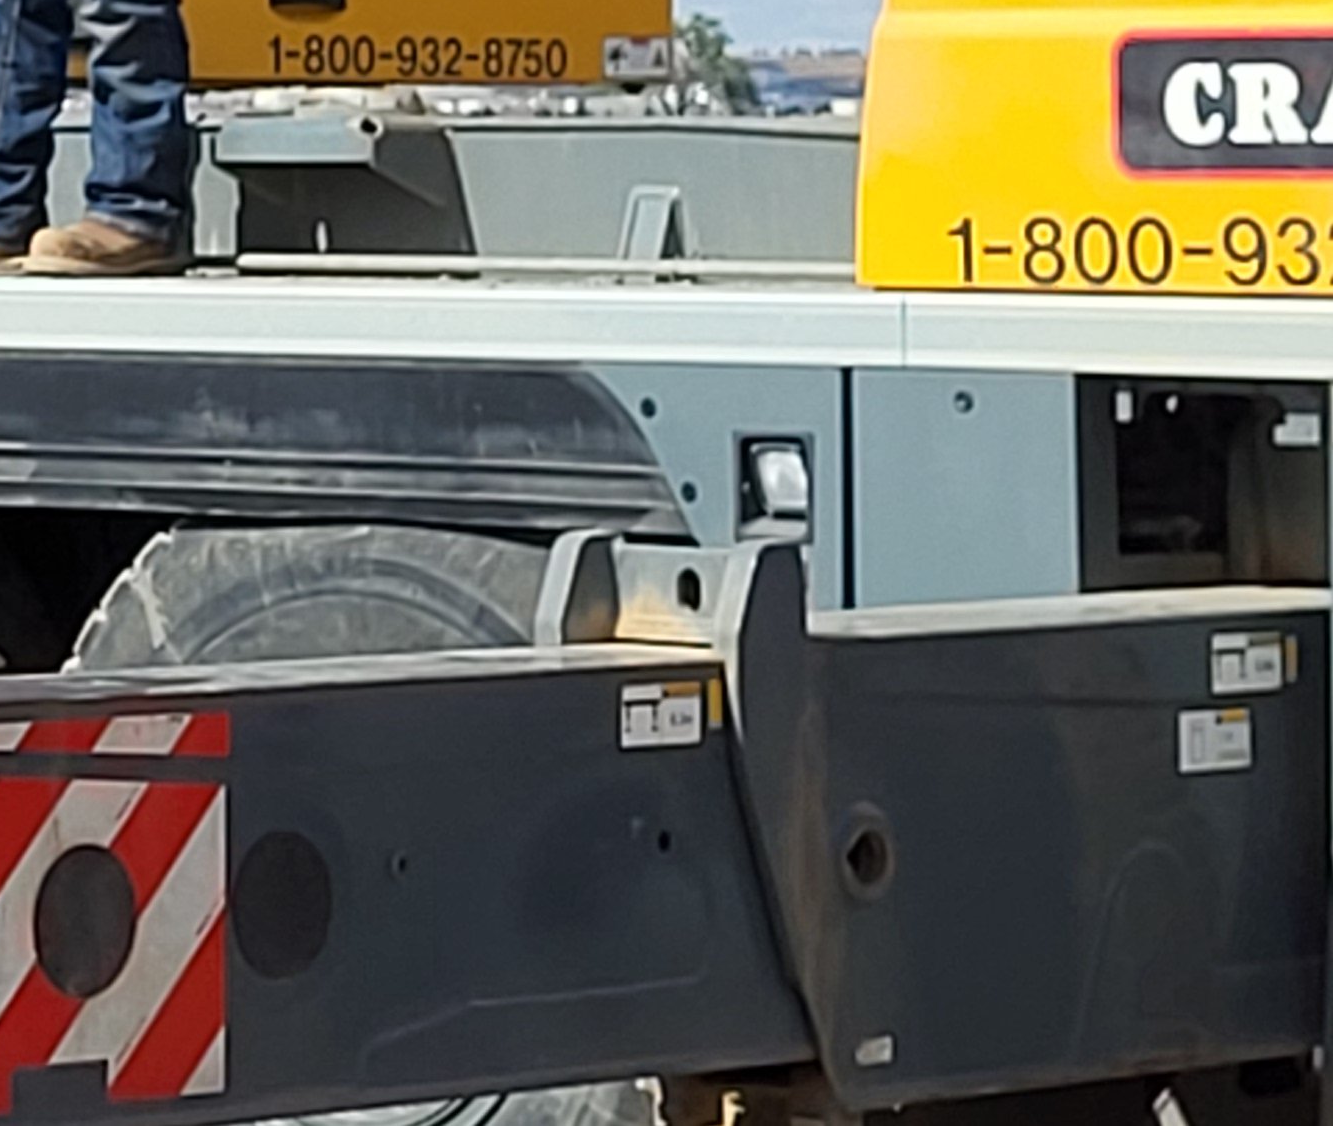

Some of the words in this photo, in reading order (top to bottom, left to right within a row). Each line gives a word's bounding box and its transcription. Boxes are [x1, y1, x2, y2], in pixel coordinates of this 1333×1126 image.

[268, 34, 568, 78] 1-800-932-8750
[1162, 60, 1333, 147] CR
[947, 216, 1333, 286] 1-800-93
